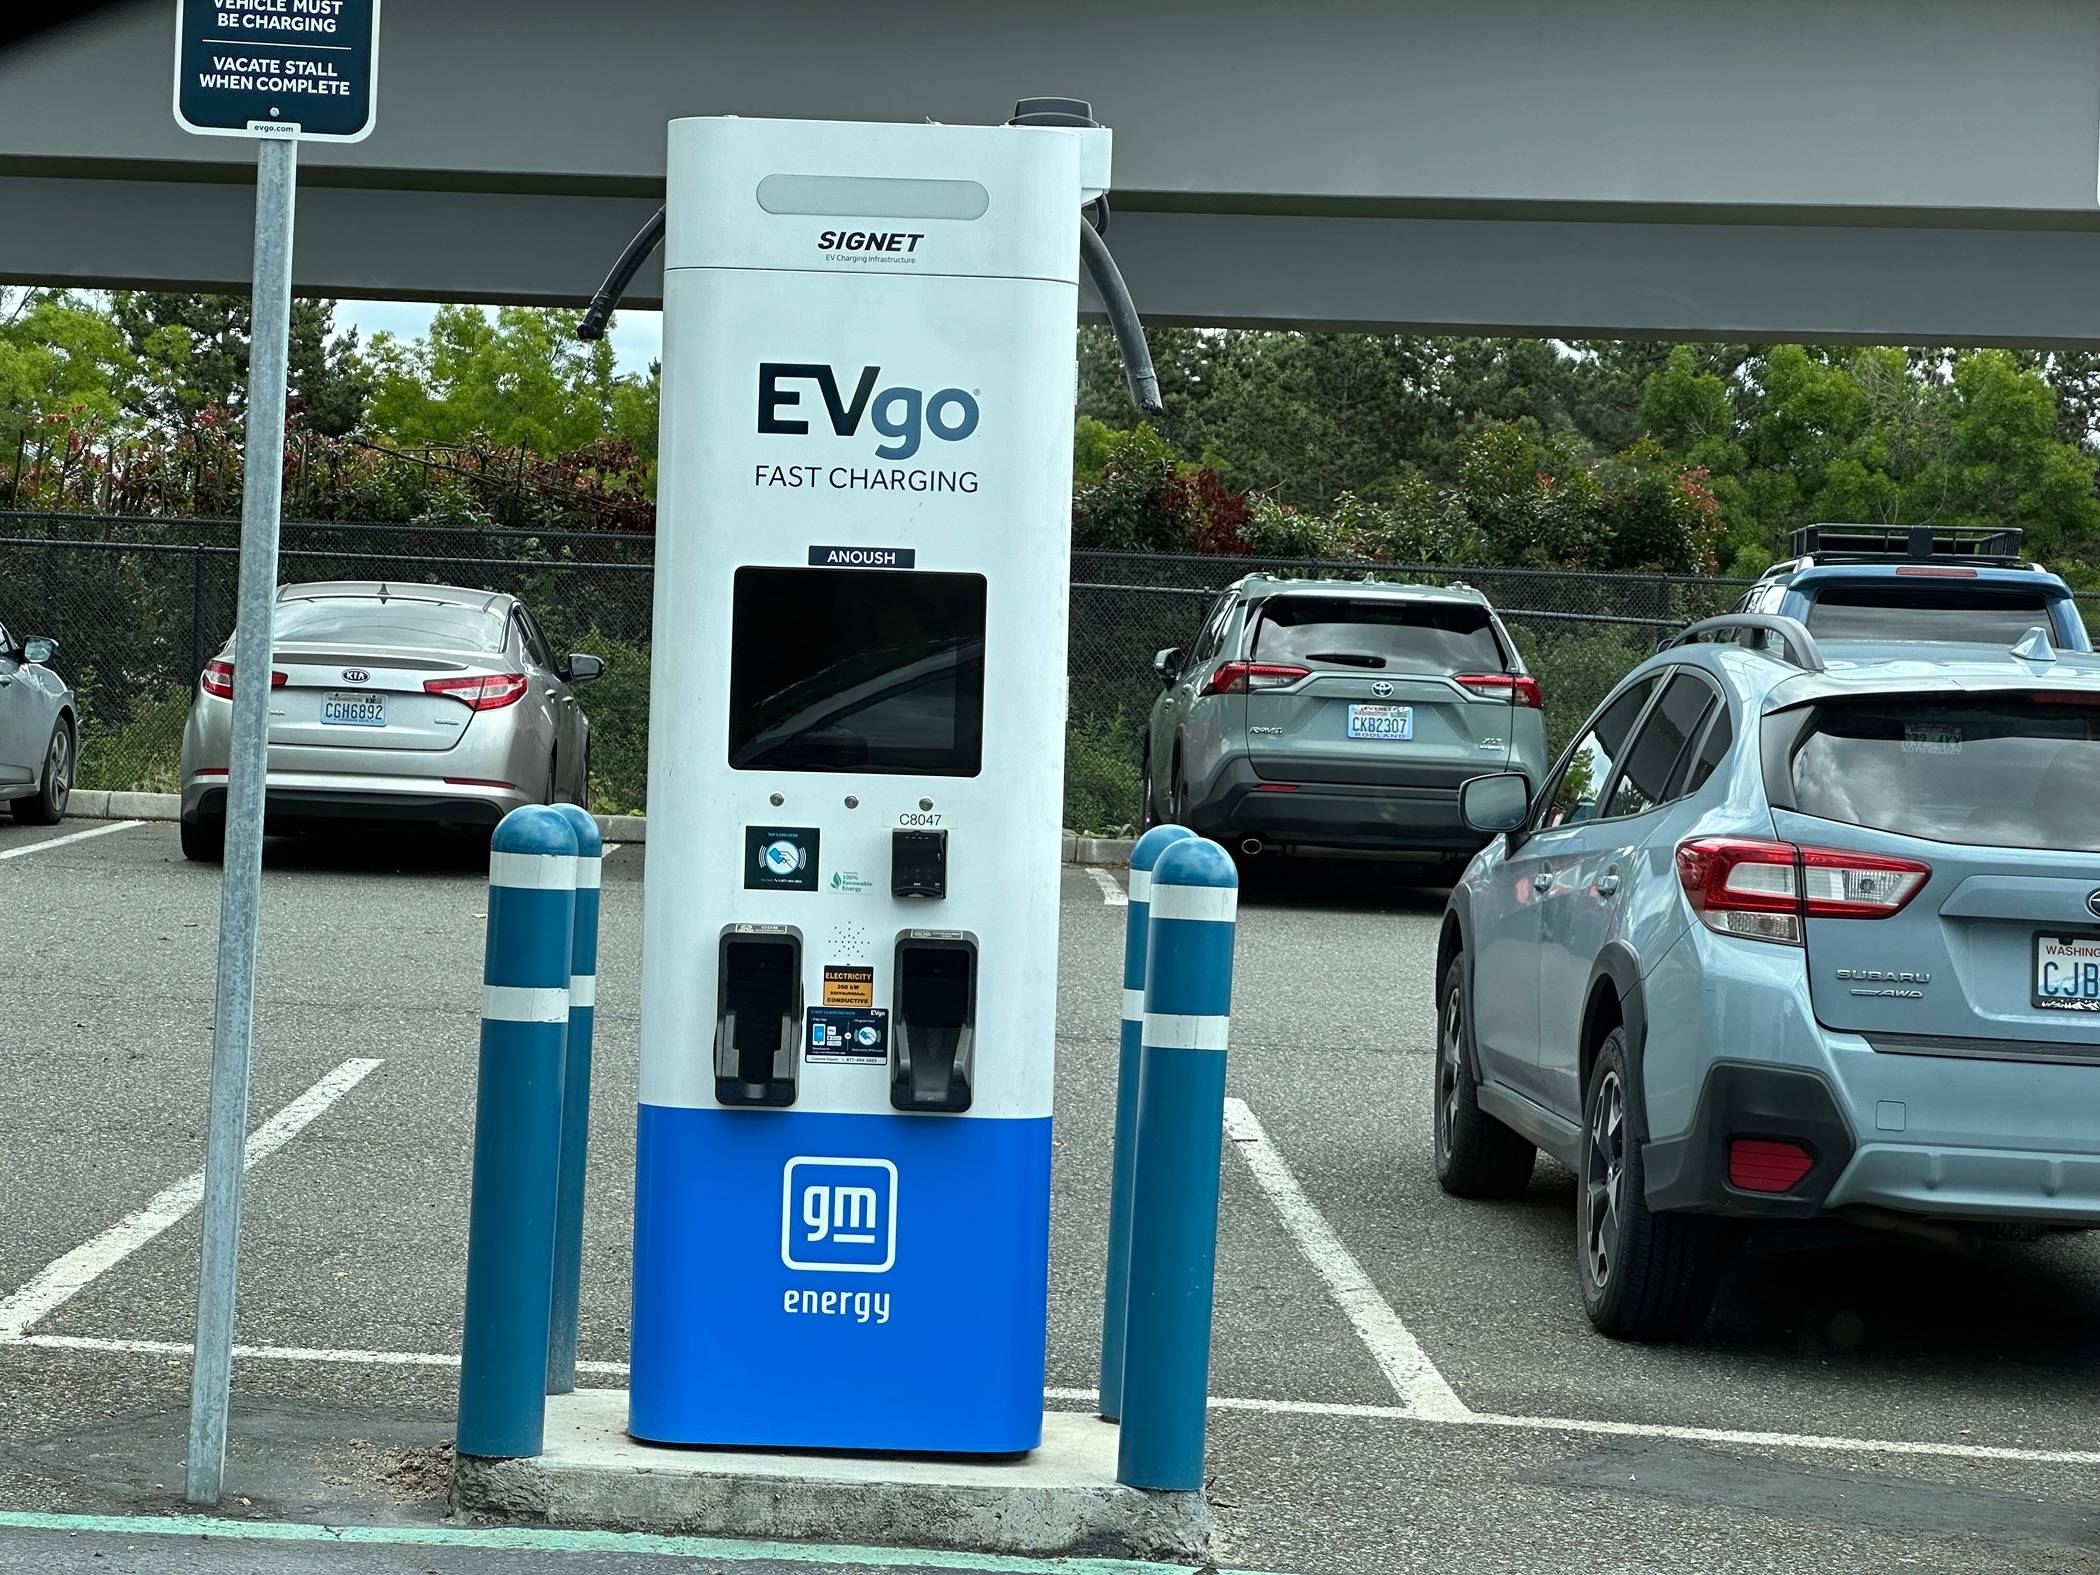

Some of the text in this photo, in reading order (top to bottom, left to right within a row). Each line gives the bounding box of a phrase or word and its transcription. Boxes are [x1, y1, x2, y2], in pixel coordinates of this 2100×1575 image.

[214, 0, 343, 15] VEHICLE MUST
[217, 13, 336, 33] BE CHARGING
[213, 56, 338, 77] VACATE STALL
[200, 74, 350, 96] WHEN COMPLETE
[254, 125, 294, 133] evgo.com
[817, 231, 925, 252] SIGNET
[836, 254, 867, 263] Charging
[868, 255, 916, 263] Infrastructure
[758, 363, 980, 460] EVgo
[755, 465, 979, 493] FAST CHARGING
[827, 550, 896, 565] ANOUSH
[346, 671, 365, 680] KIA
[325, 702, 383, 720] CGH6892
[1352, 716, 1407, 734] CKB2307
[900, 813, 942, 826] C8047
[825, 972, 872, 980] ELECTRICITY
[1836, 969, 1932, 984] SUBARU
[1878, 988, 1923, 998] AWD
[803, 1185, 877, 1242] gm
[784, 1290, 890, 1323] energy
